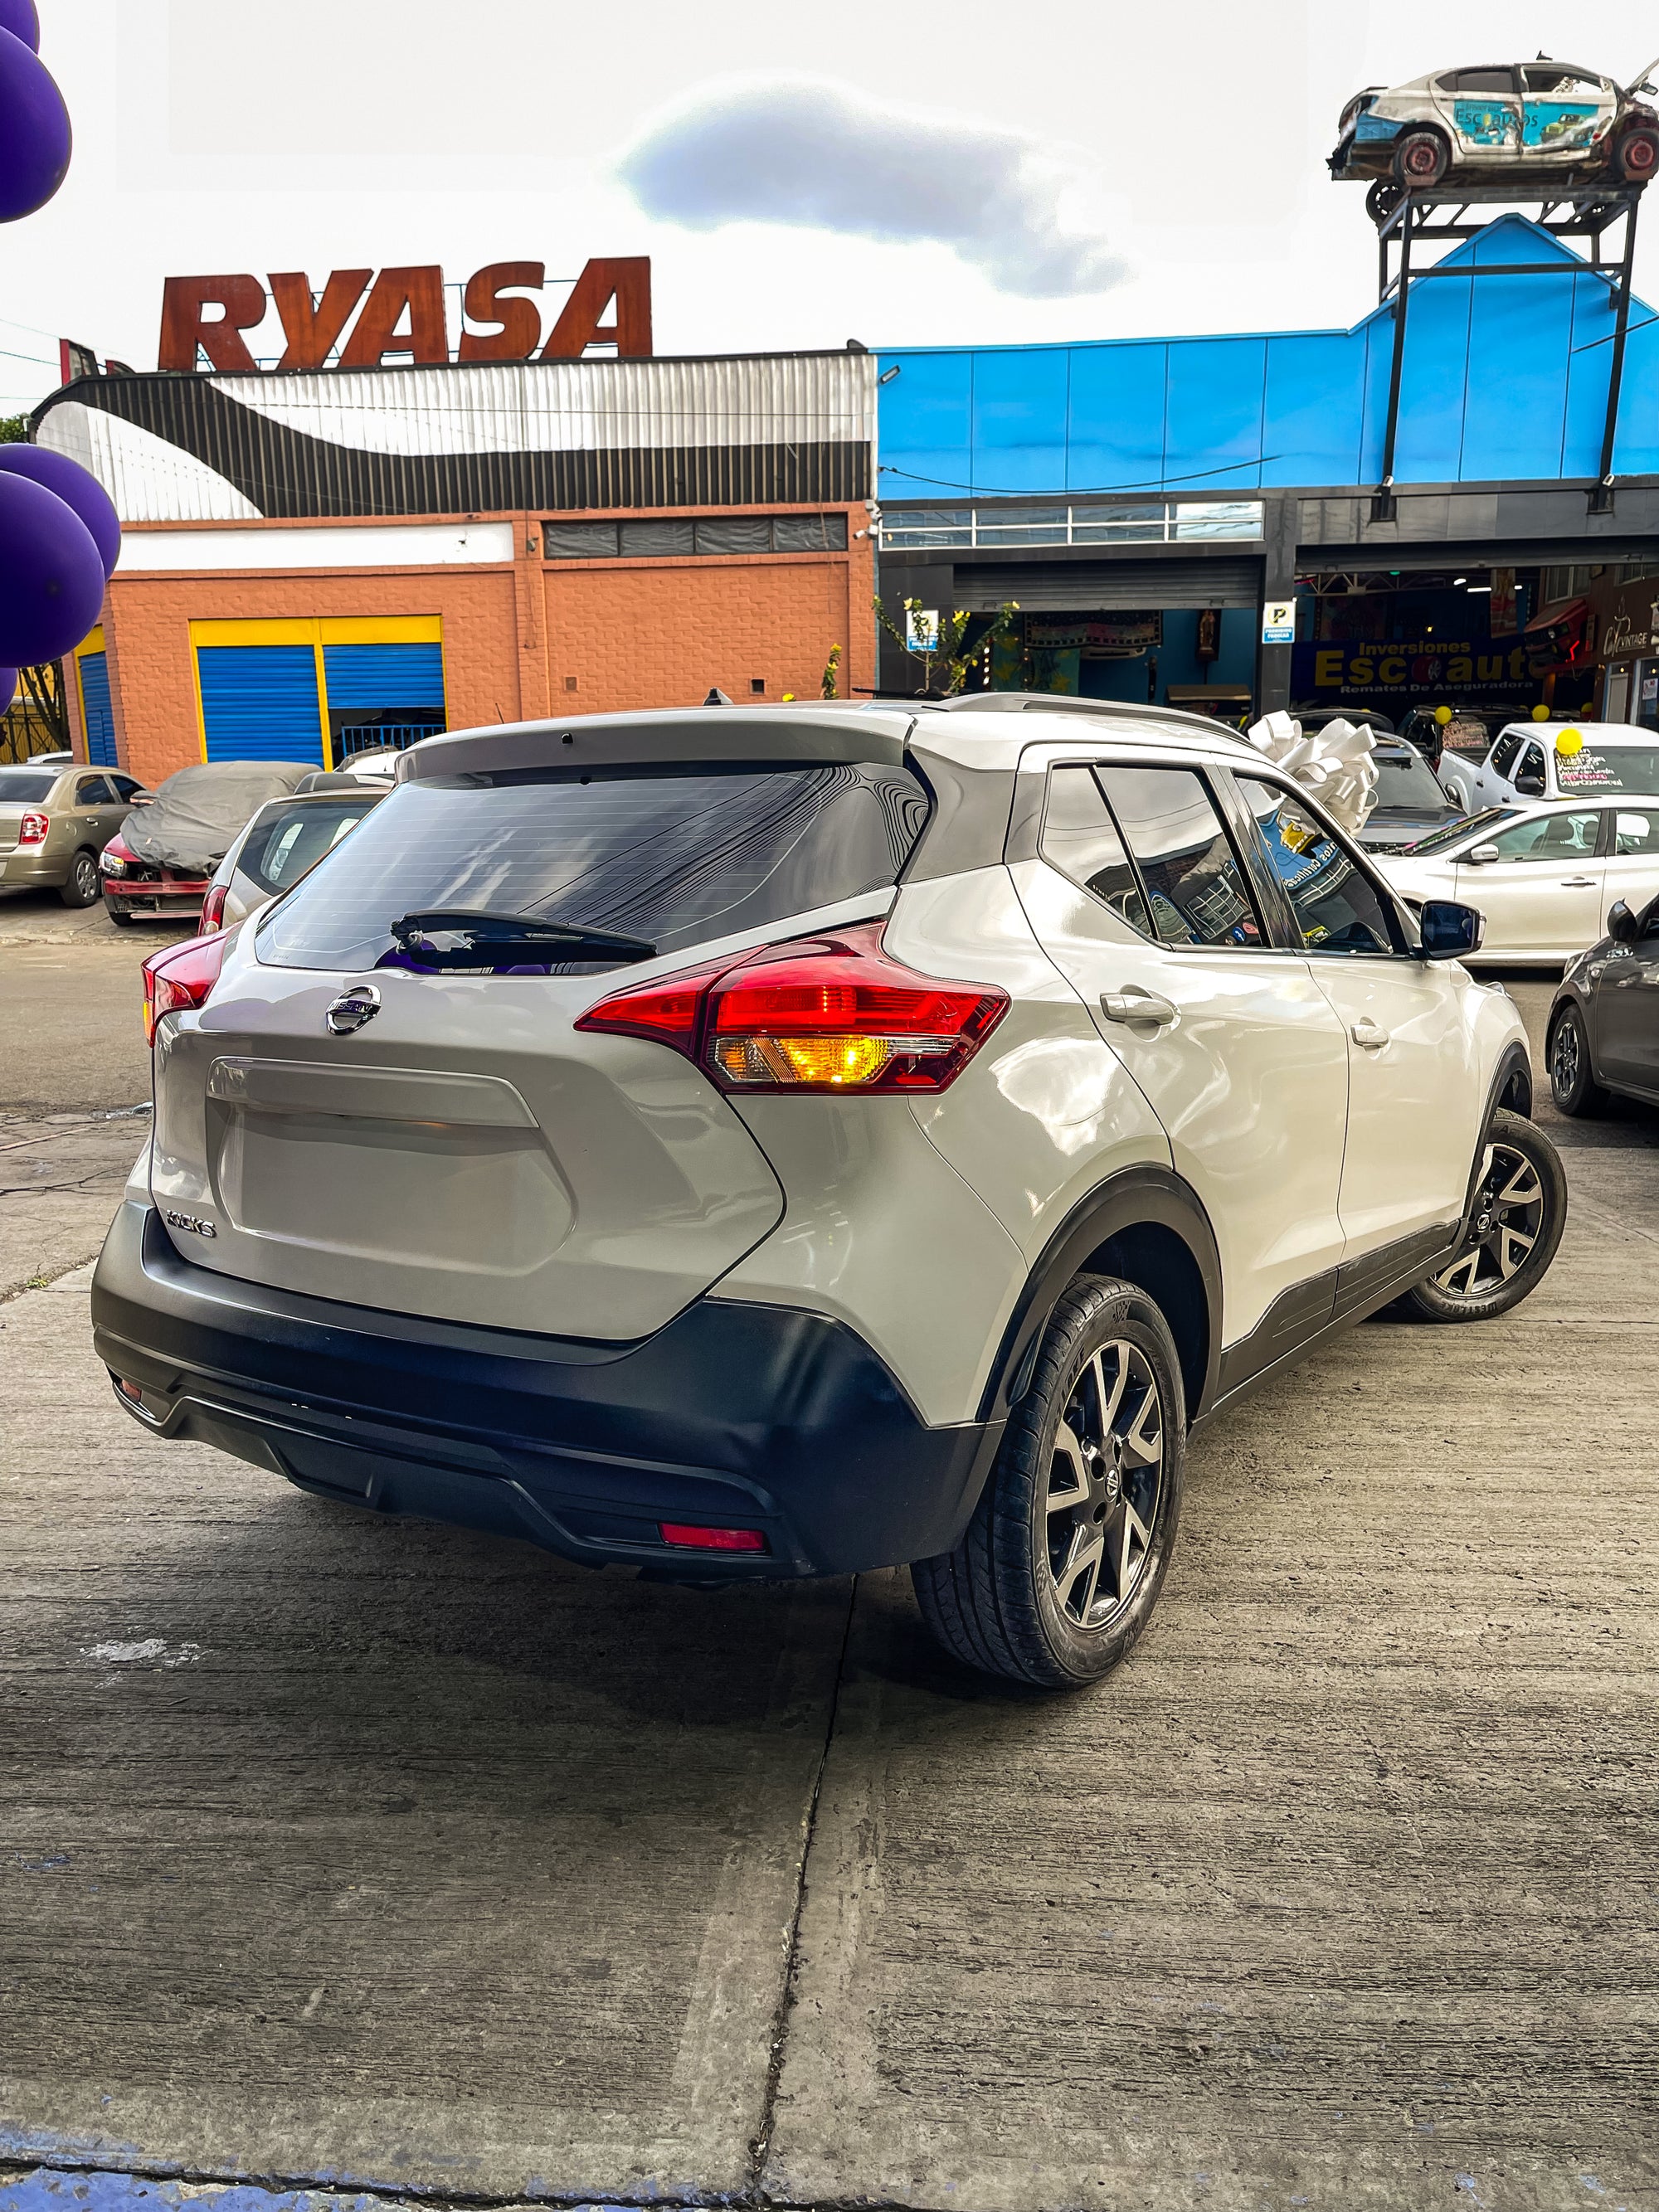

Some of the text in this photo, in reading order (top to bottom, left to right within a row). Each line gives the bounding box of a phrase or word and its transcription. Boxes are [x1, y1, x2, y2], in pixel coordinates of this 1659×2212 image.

[158, 255, 654, 372] RYASA
[1359, 641, 1472, 656] Inversiones
[1340, 681, 1534, 694] Remates De Aseguradora
[328, 1000, 373, 1014] NISSAN
[166, 1208, 216, 1238] KICKS
